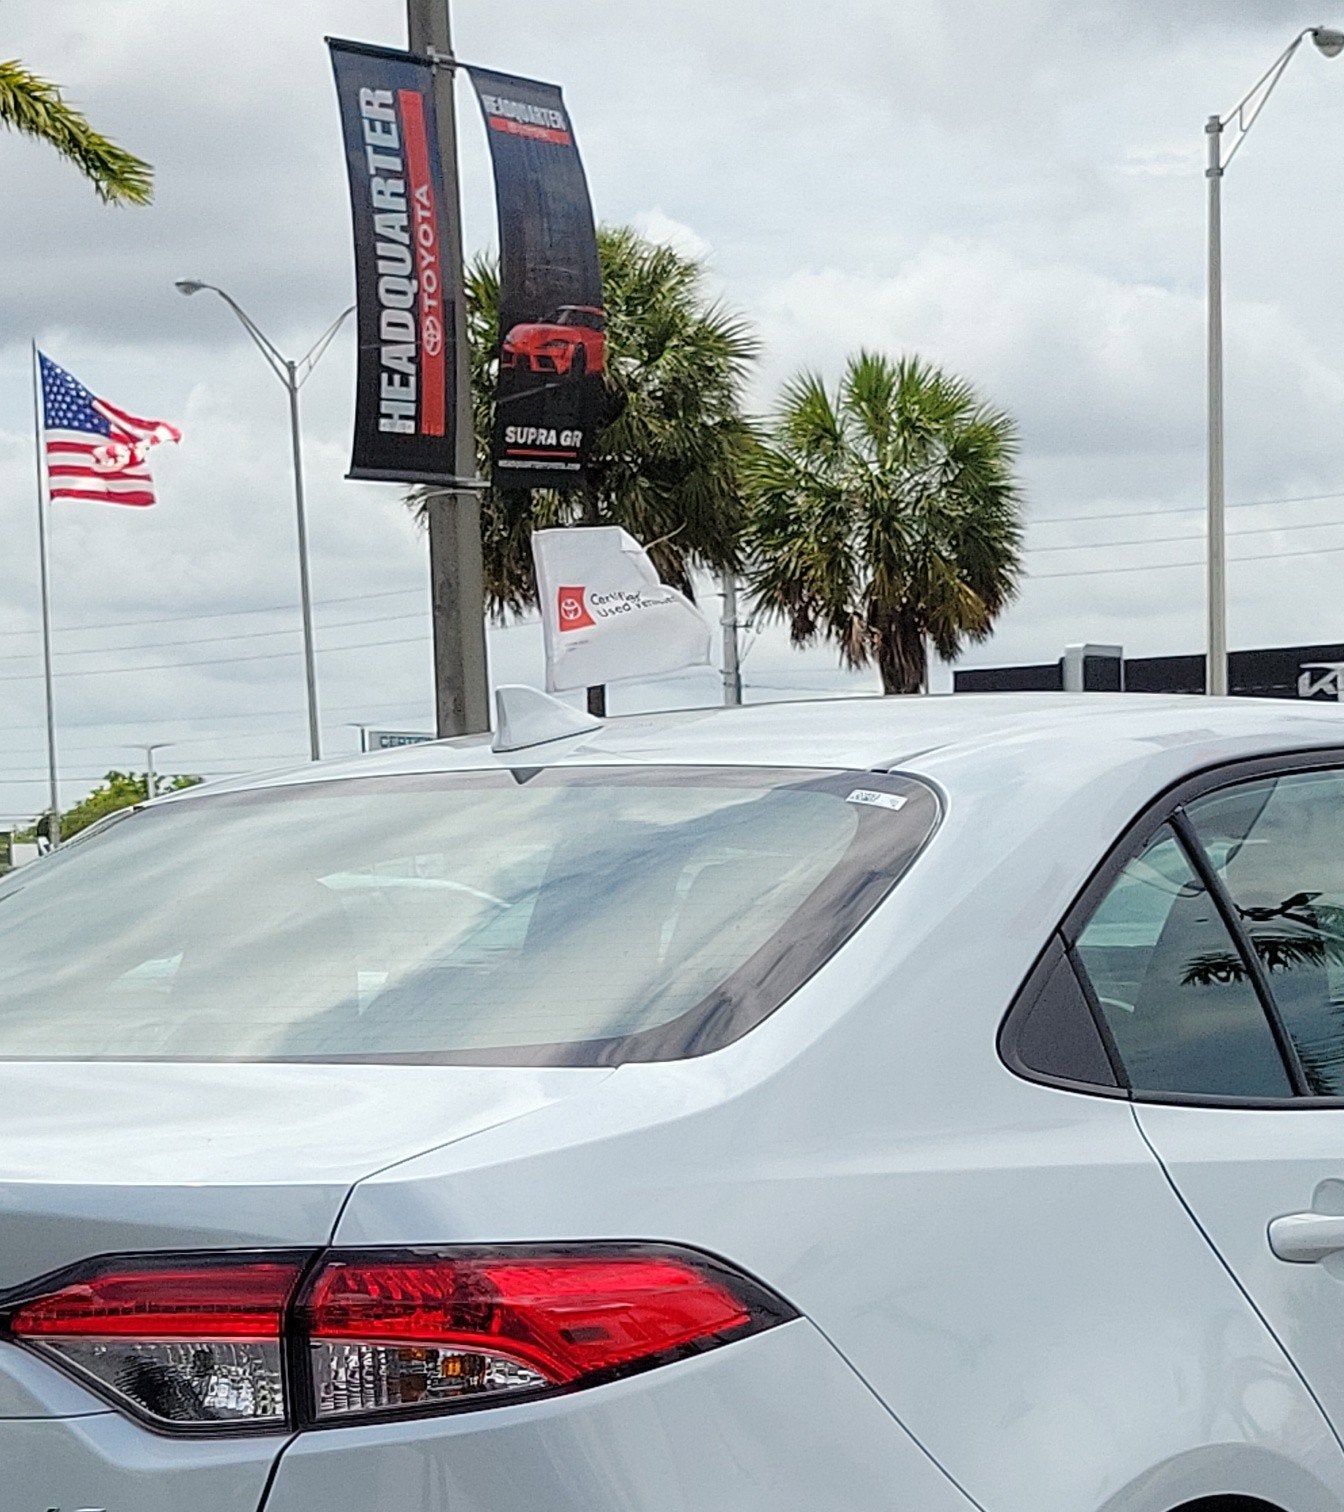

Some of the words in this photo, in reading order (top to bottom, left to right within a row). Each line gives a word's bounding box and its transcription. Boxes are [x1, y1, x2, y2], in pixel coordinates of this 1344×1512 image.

[359, 87, 416, 434] HEADQUARTER
[413, 184, 444, 312] TOYOTA
[505, 426, 558, 446] SUPRA
[560, 430, 583, 448] GR
[597, 602, 631, 618] Used
